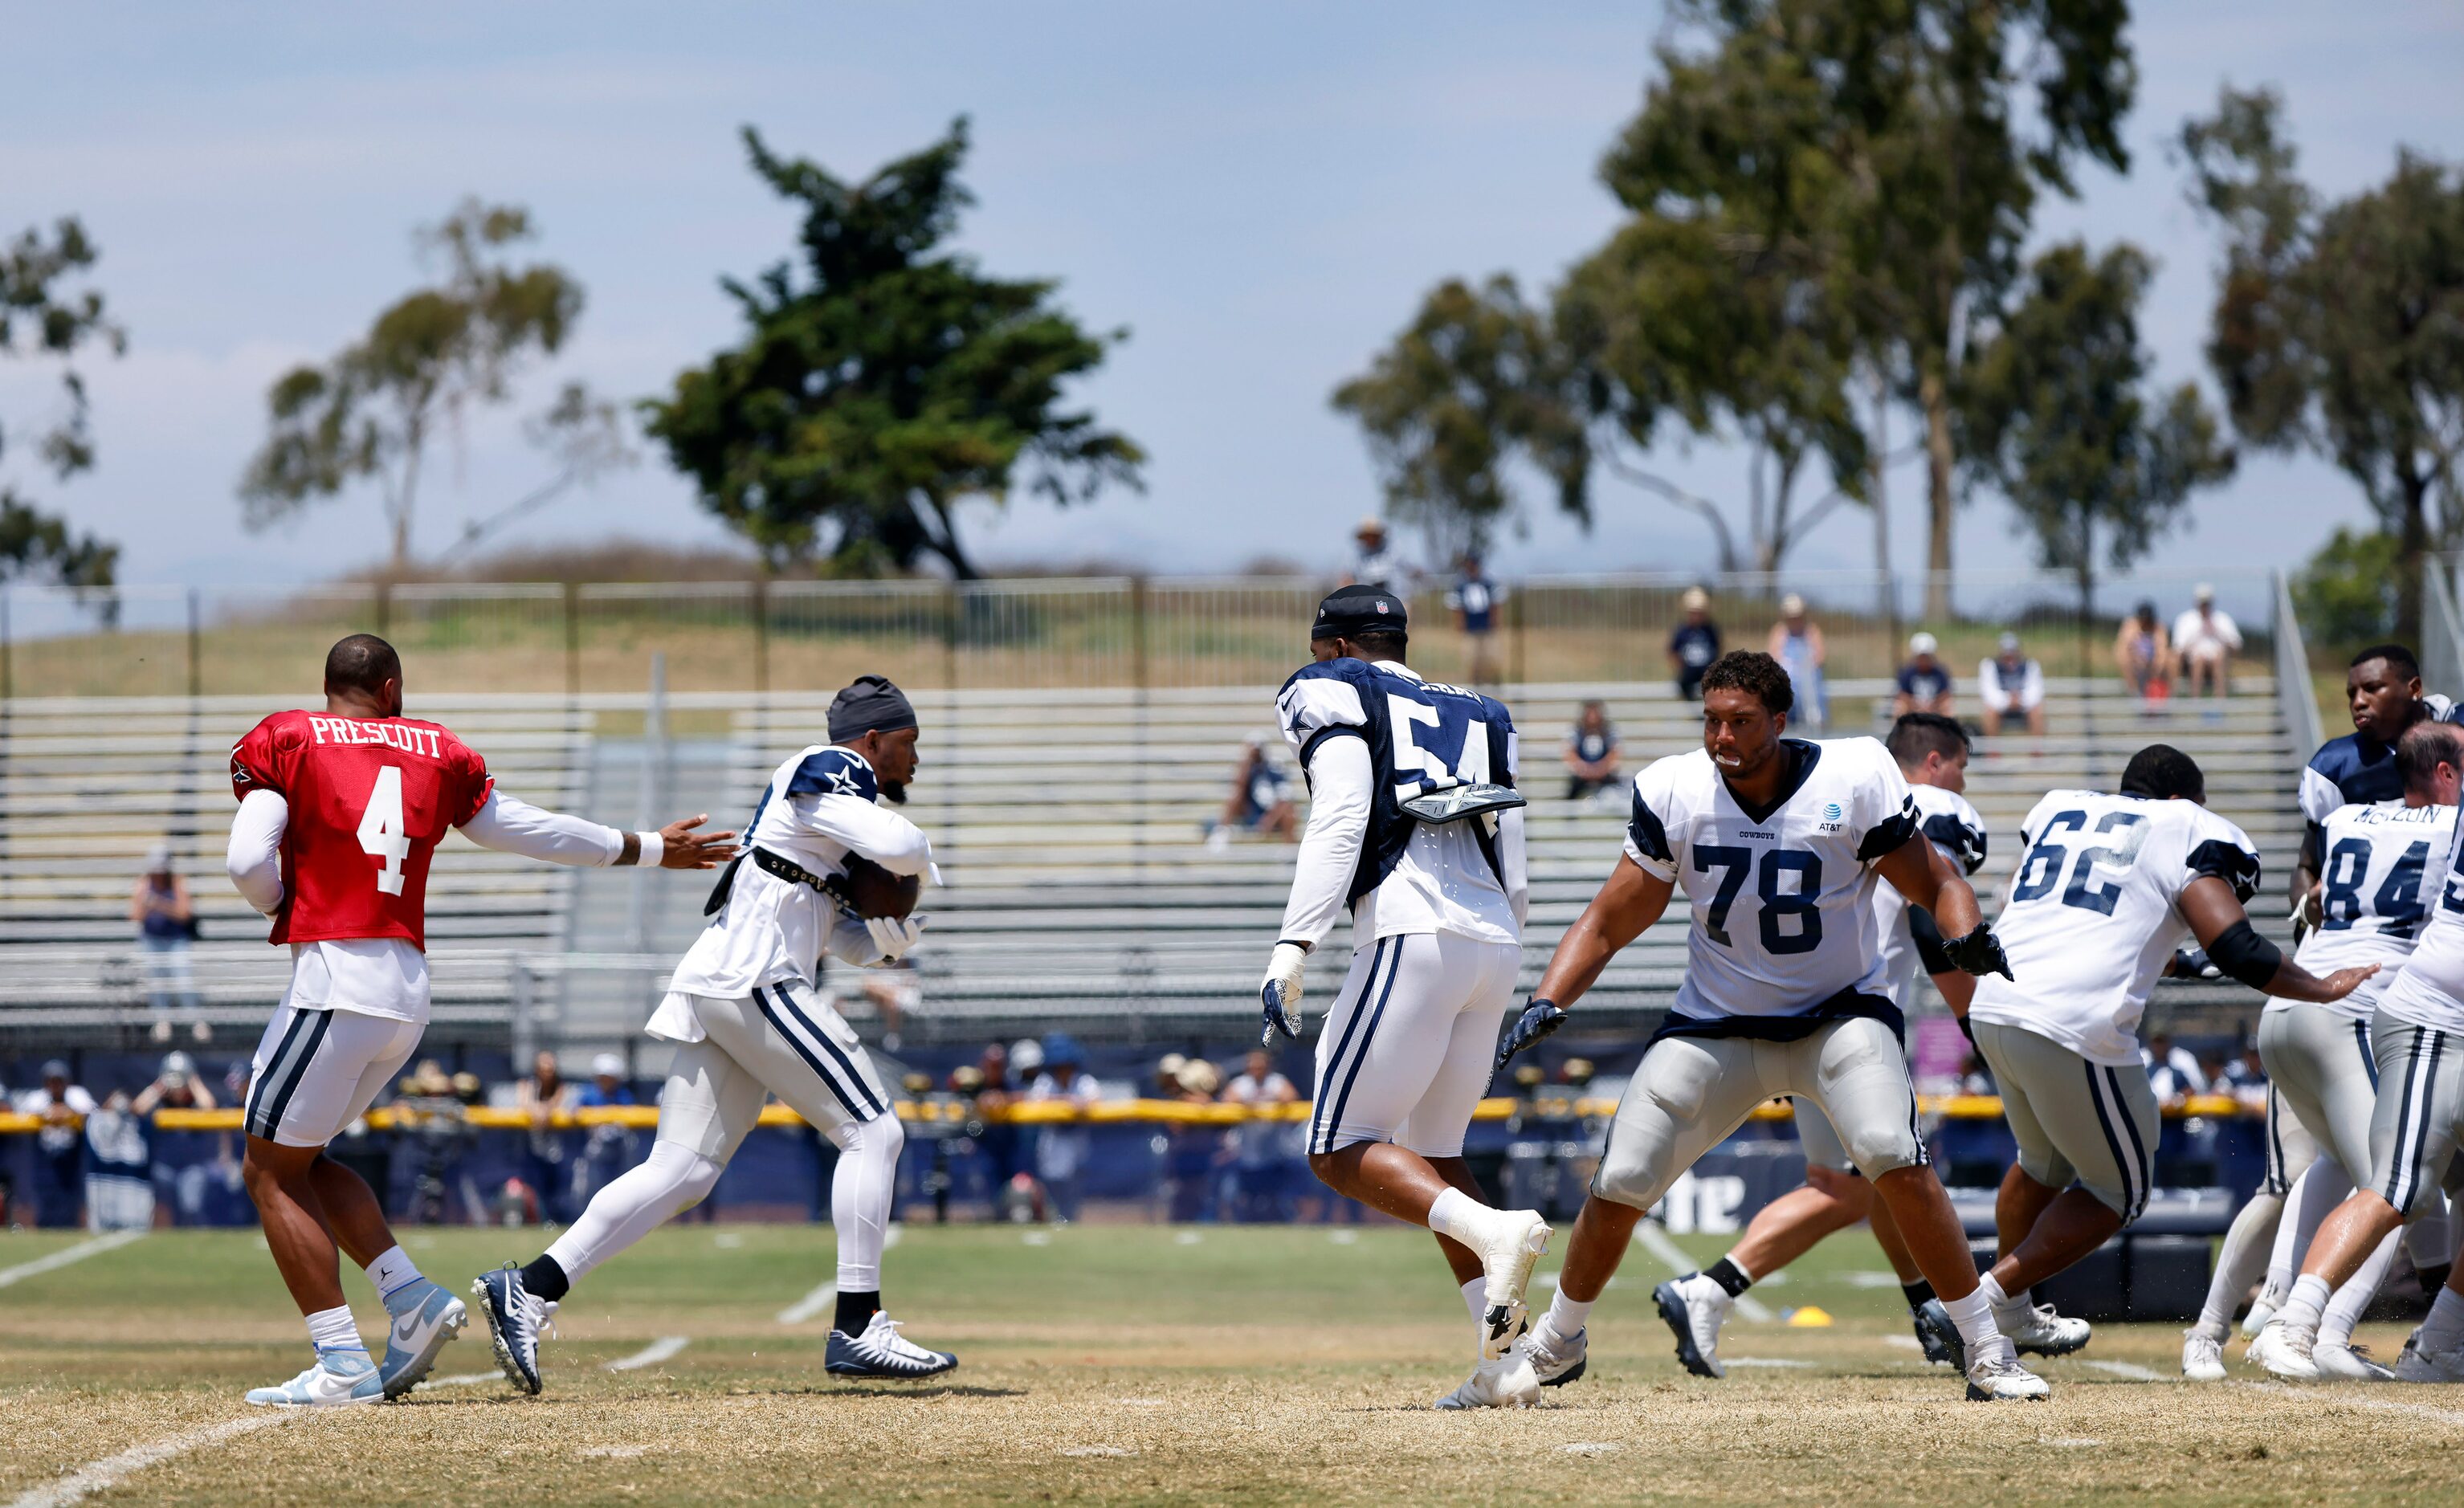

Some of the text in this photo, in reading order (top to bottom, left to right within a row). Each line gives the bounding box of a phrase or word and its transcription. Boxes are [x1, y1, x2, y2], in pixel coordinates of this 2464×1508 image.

[308, 716, 440, 759] PRESCOTT
[1386, 691, 1499, 839] 54
[356, 764, 411, 897] 4
[1740, 831, 1775, 840] COWBOYS
[1819, 823, 1842, 832] AT&T
[2013, 810, 2153, 917] 62
[1692, 844, 1823, 955] 78
[2323, 838, 2431, 939] 84
